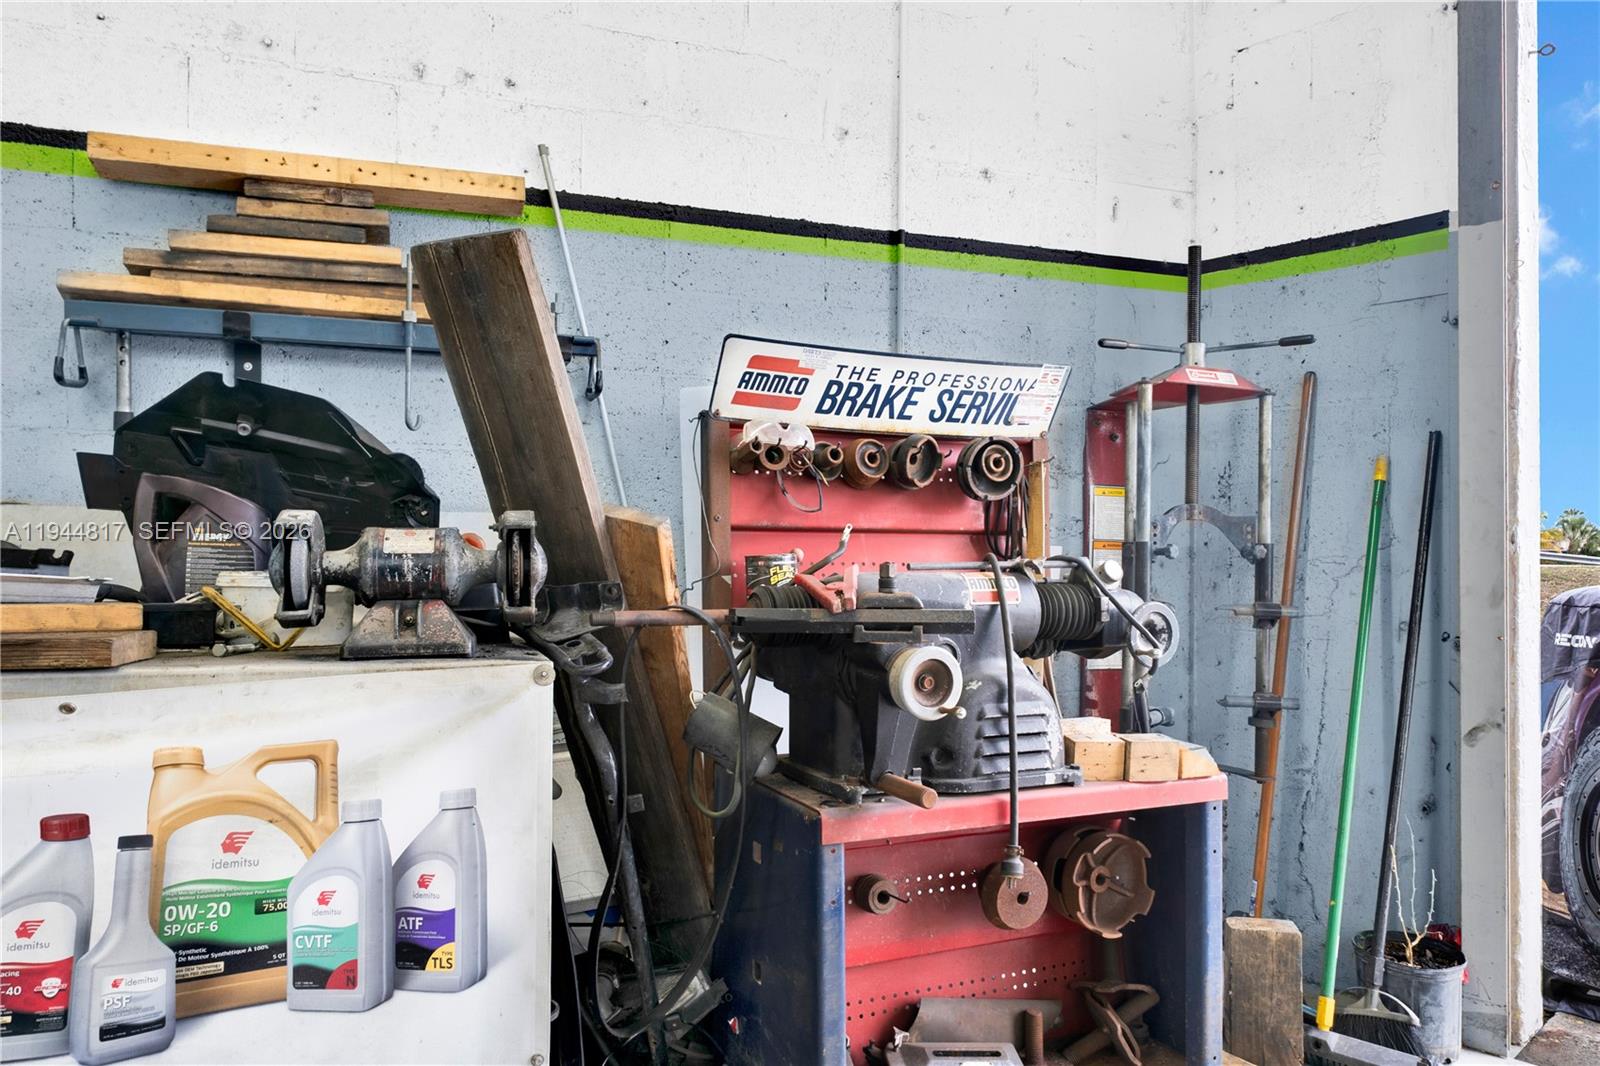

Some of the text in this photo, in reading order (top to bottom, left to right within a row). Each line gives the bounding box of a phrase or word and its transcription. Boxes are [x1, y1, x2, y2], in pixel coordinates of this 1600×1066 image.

[737, 371, 810, 396] AMMCO
[835, 365, 881, 383] THE
[891, 370, 1038, 393] PROFESSIONA
[814, 379, 926, 421] BRAKE
[928, 389, 1030, 426] SERVIC
[211, 857, 260, 870] idemitsu
[164, 901, 231, 922] 0W-20
[312, 908, 342, 917] idemitsu
[163, 921, 219, 937] SP/GF-6
[398, 917, 424, 930] ATF
[6, 941, 51, 952] idemitsu
[295, 934, 333, 949] CVTF
[431, 957, 454, 970] TLS
[0, 970, 20, 978] acing
[125, 976, 159, 986] idemitsu
[346, 975, 355, 987] N
[0, 986, 22, 996] -40
[103, 995, 131, 1010] PSF
